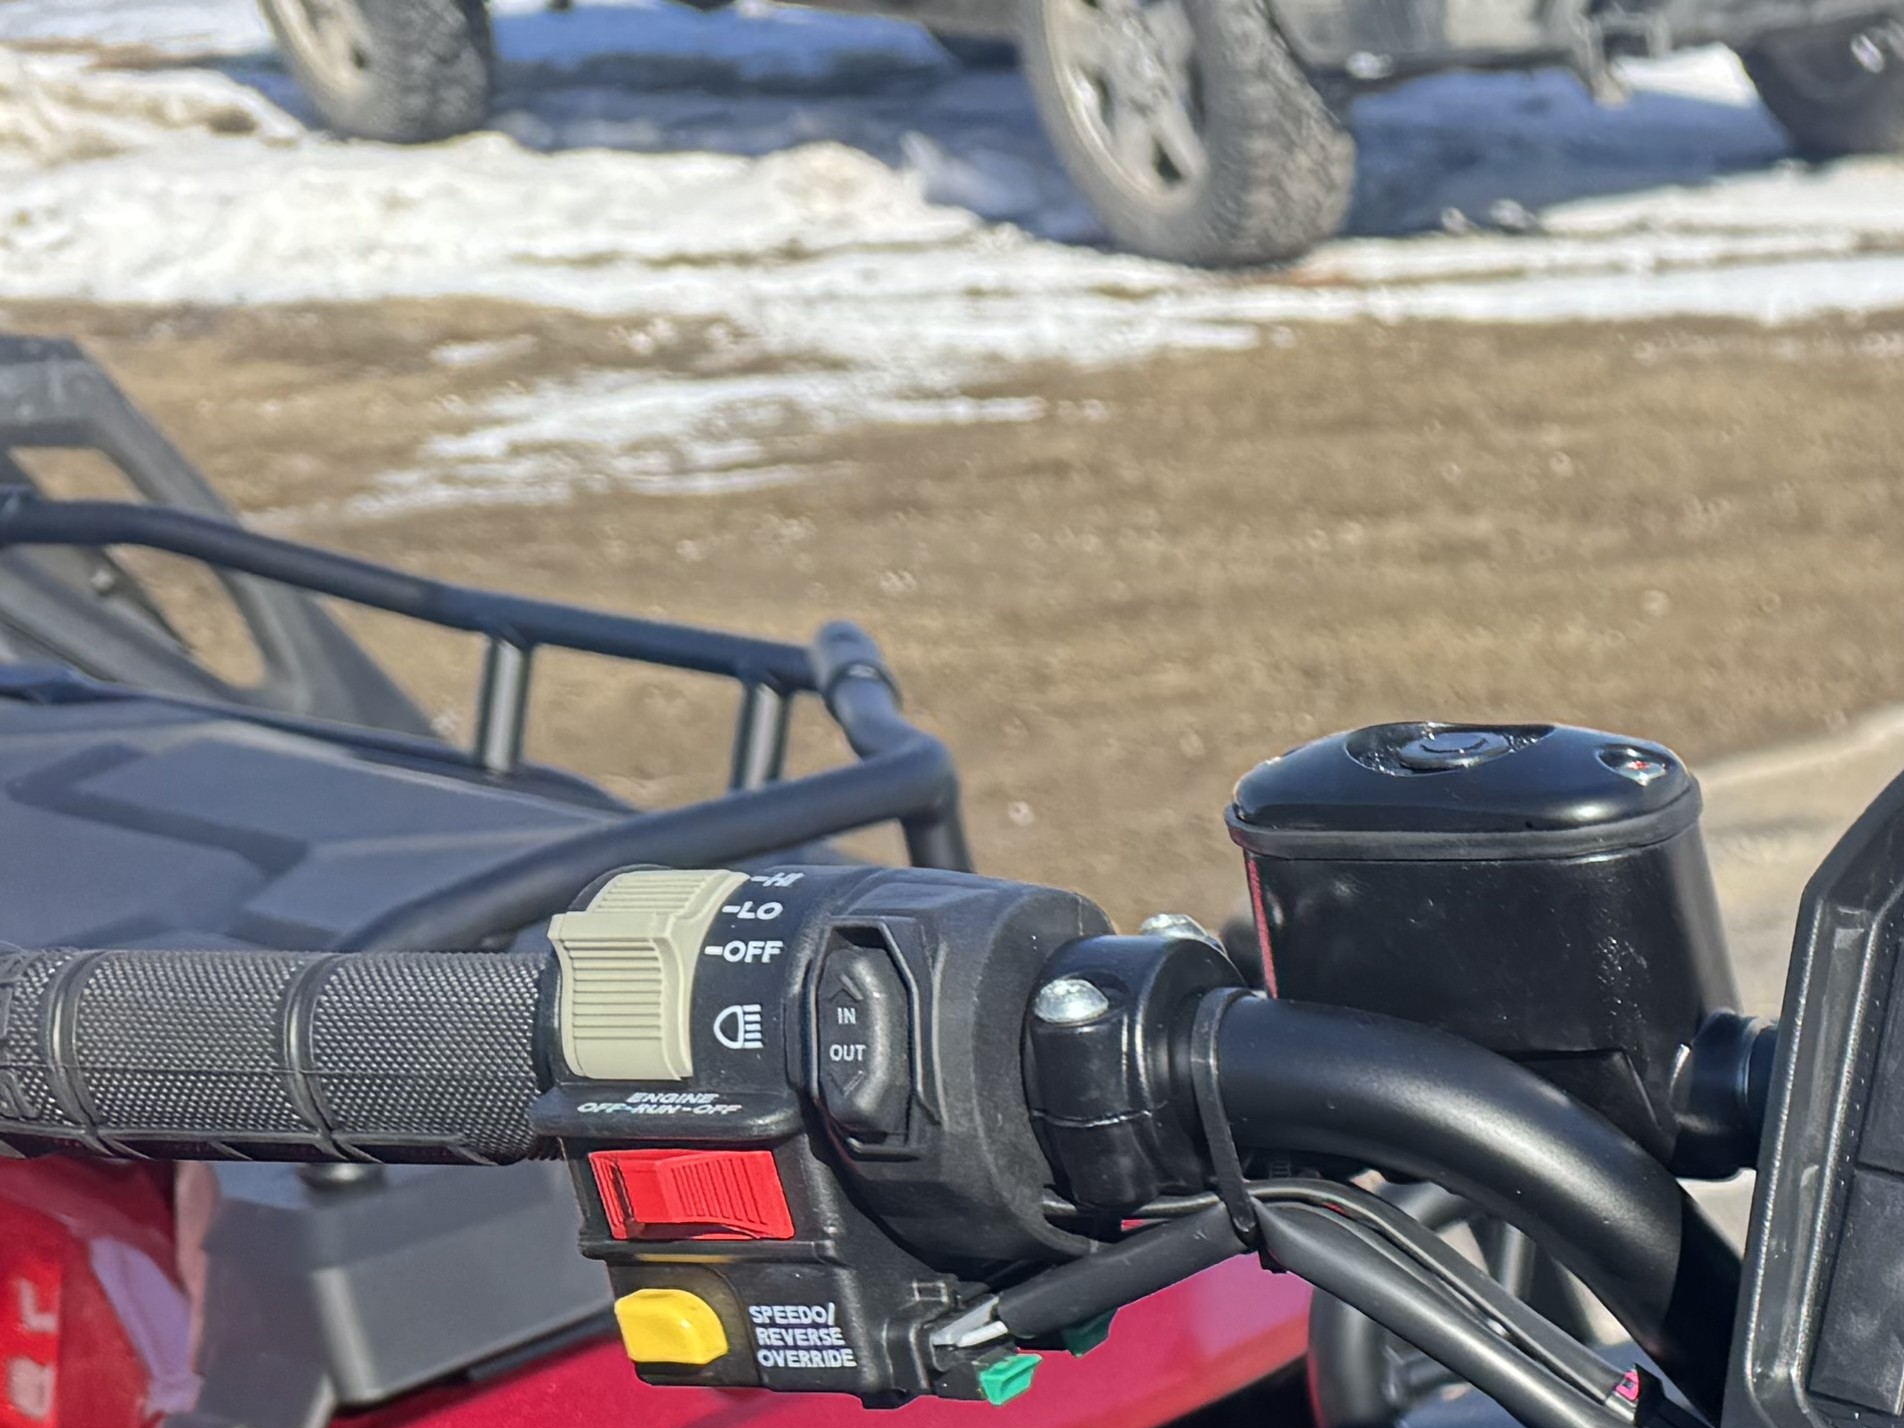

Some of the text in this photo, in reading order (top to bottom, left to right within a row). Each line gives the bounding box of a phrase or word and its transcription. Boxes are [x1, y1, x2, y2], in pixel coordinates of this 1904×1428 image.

[837, 1007, 857, 1025] IN
[829, 1044, 867, 1062] OUT
[626, 1092, 720, 1104] ENGINE
[748, 1302, 836, 1326] SPEEDO/
[755, 1326, 846, 1347] REVERSE
[756, 1347, 858, 1368] OVERRIDE
